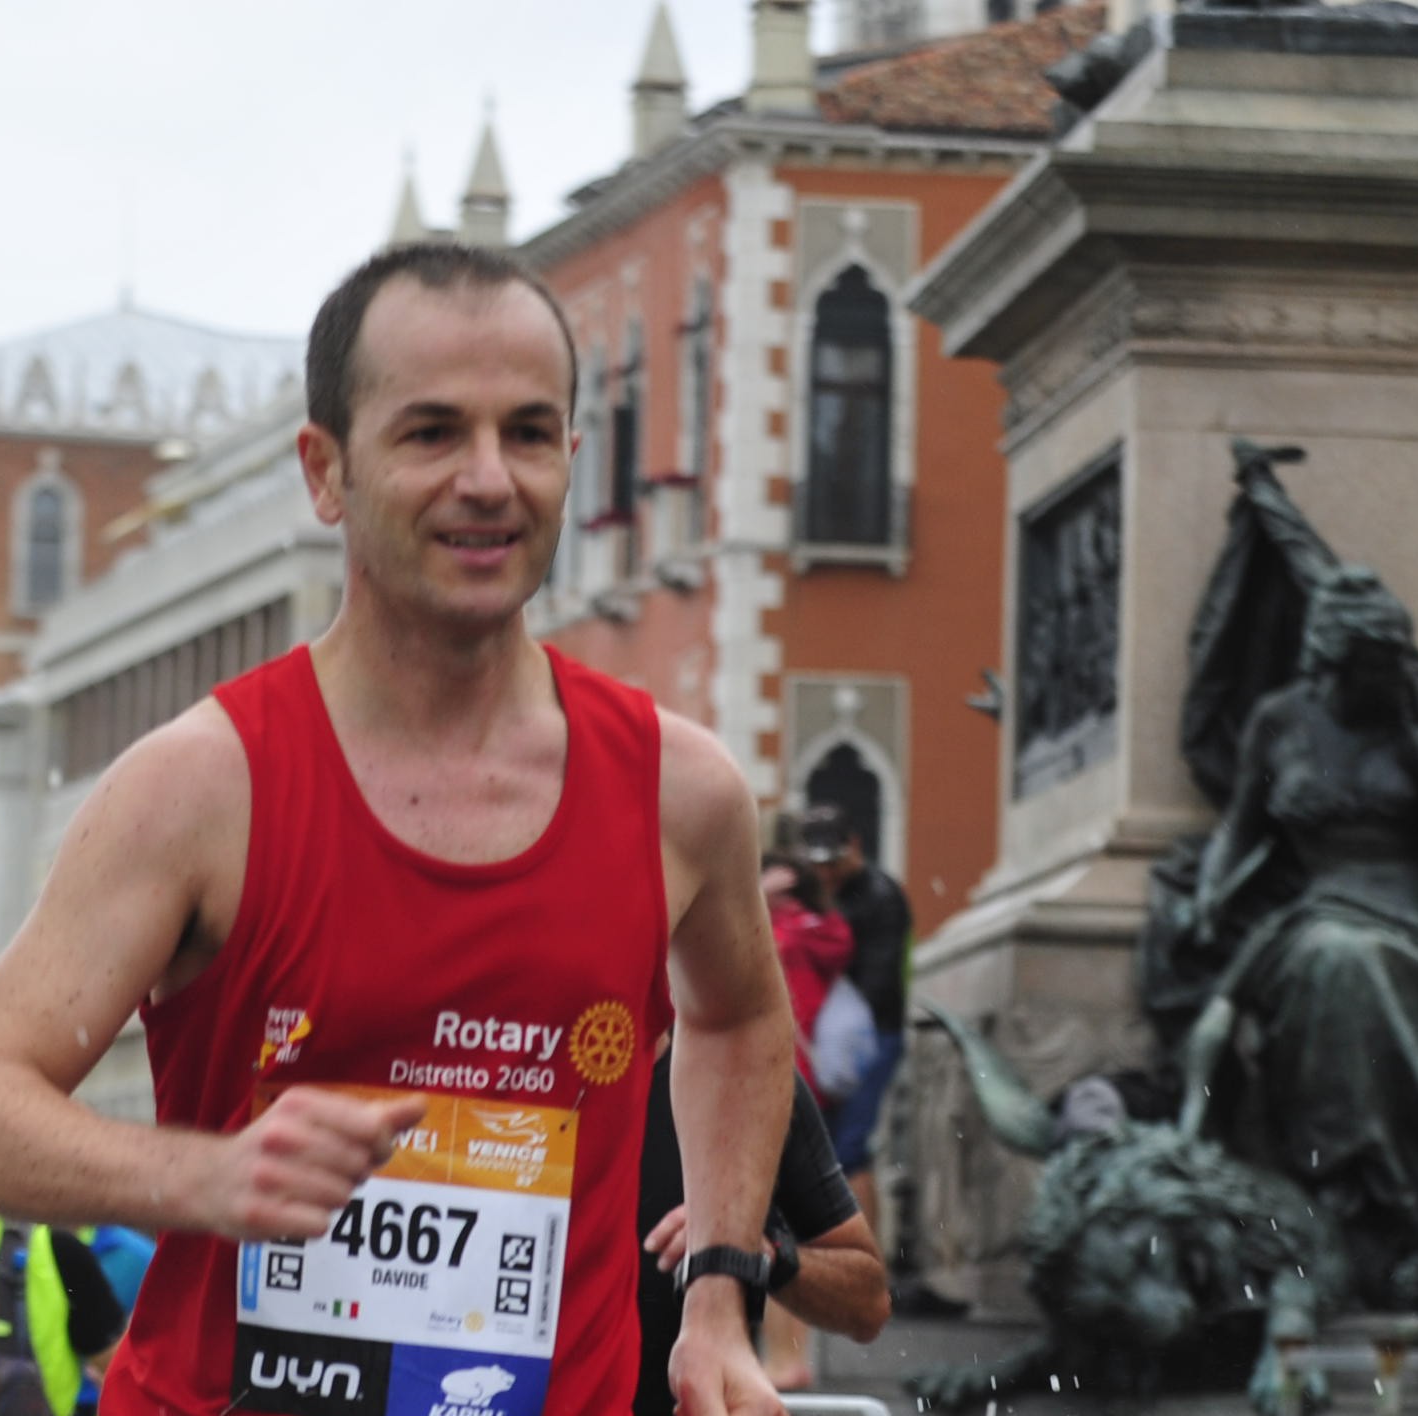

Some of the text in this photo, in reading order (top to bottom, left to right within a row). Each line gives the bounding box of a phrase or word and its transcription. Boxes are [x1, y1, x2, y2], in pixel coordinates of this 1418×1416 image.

[432, 1009, 563, 1062] Rotary
[389, 1058, 556, 1094] Distretto 2060
[467, 1138, 548, 1164] VENICE
[331, 1198, 479, 1268] 4667
[371, 1266, 429, 1291] DAVIDE
